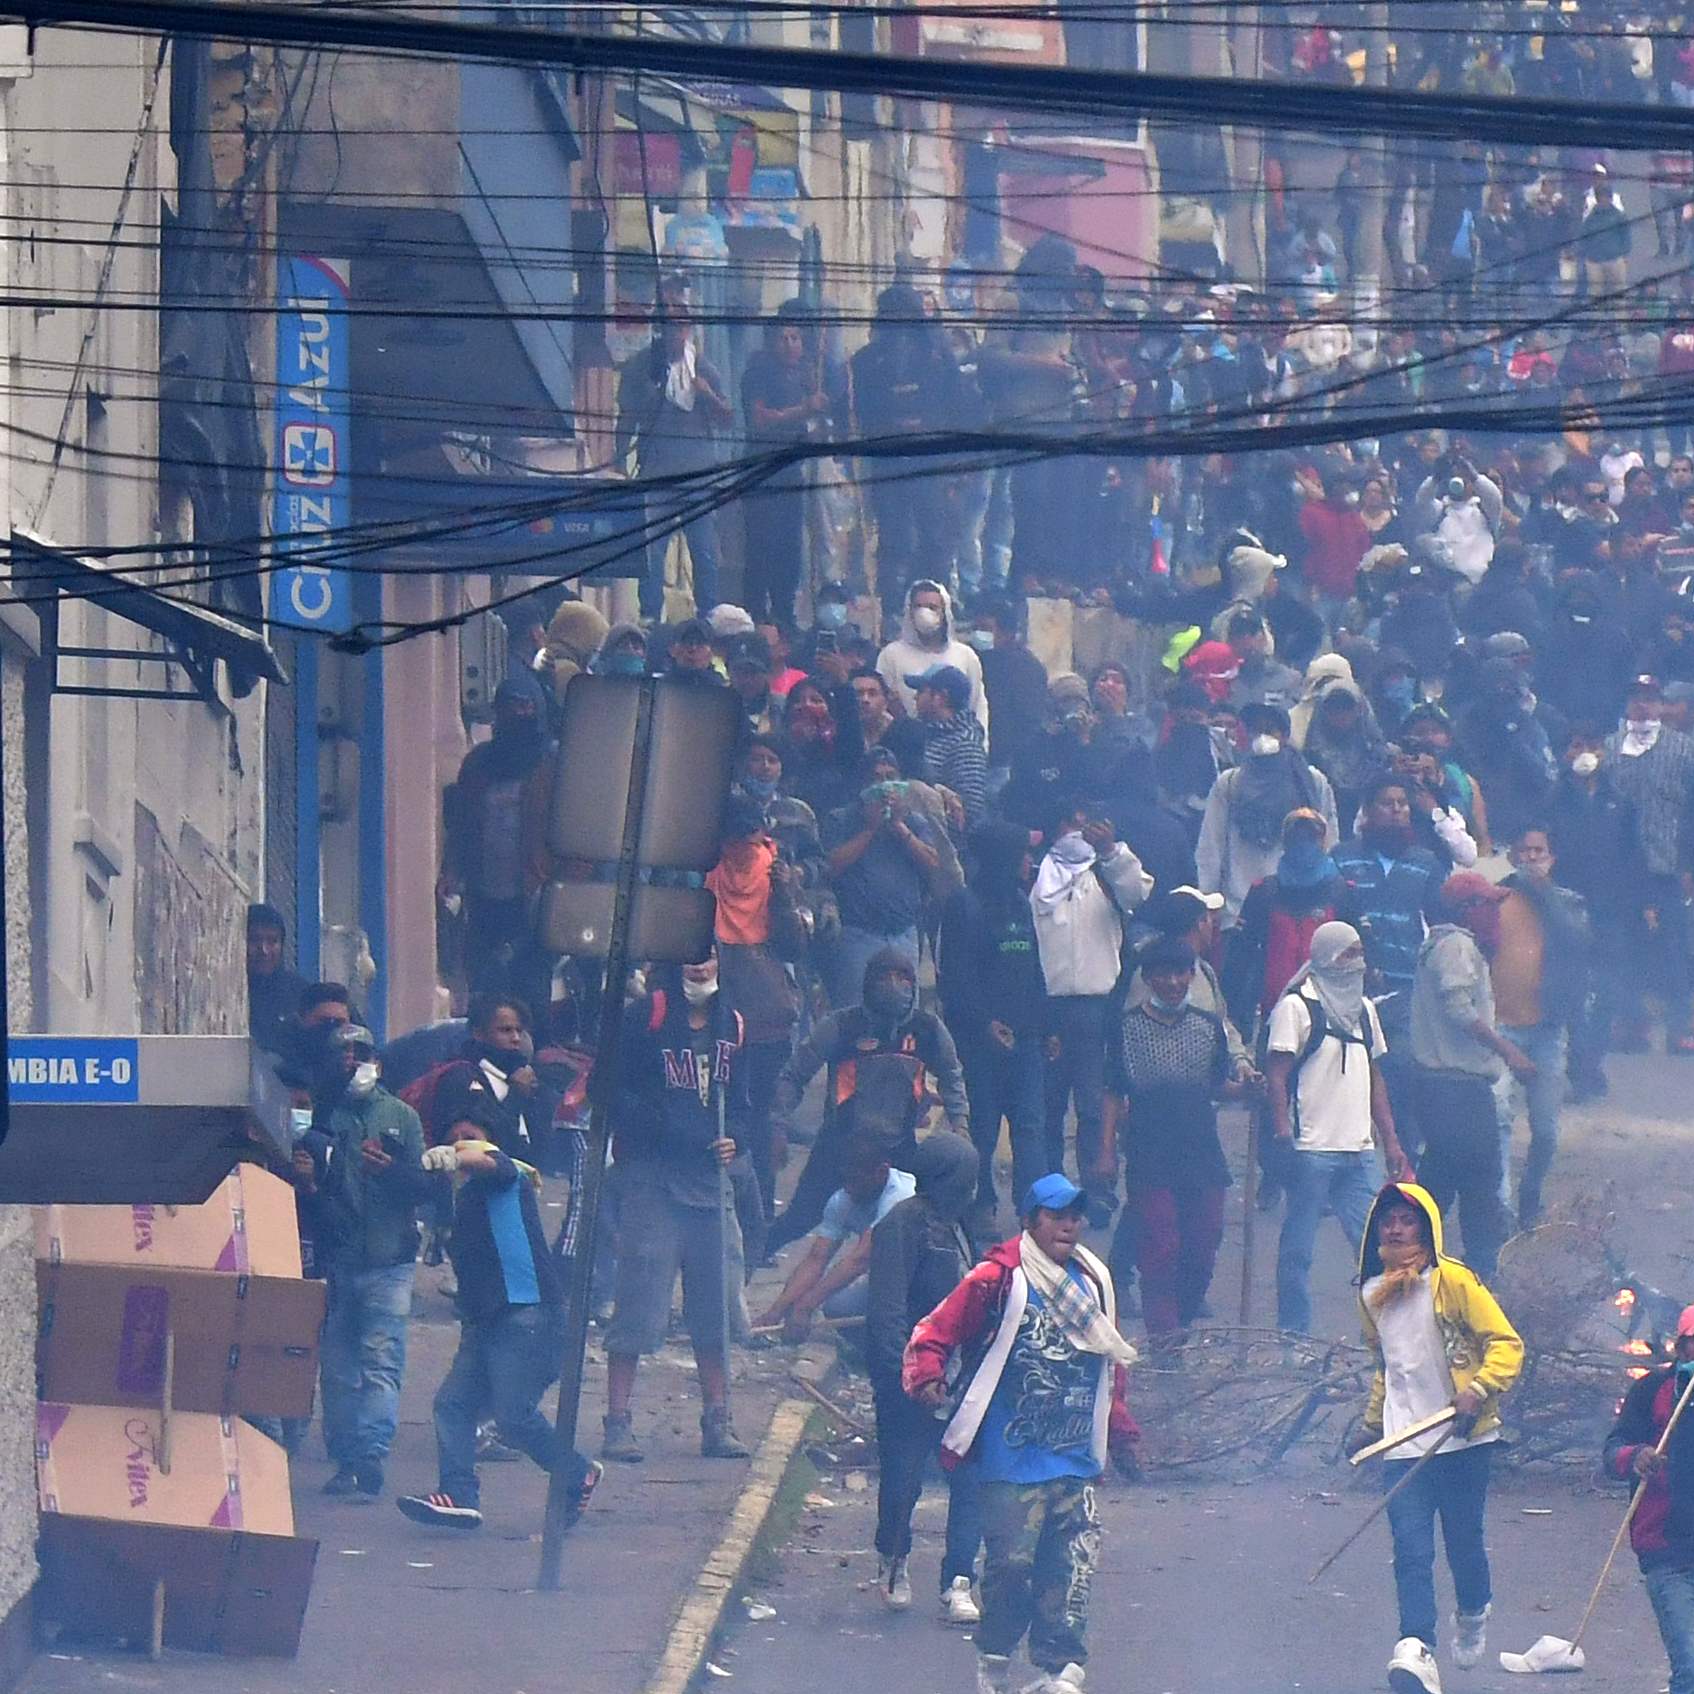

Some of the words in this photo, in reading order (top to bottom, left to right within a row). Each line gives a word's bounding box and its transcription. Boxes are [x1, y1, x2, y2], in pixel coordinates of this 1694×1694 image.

[288, 297, 330, 412] Azul
[291, 495, 332, 619] Cruz
[8, 1058, 79, 1084] MBIA
[85, 1057, 131, 1085] E-O
